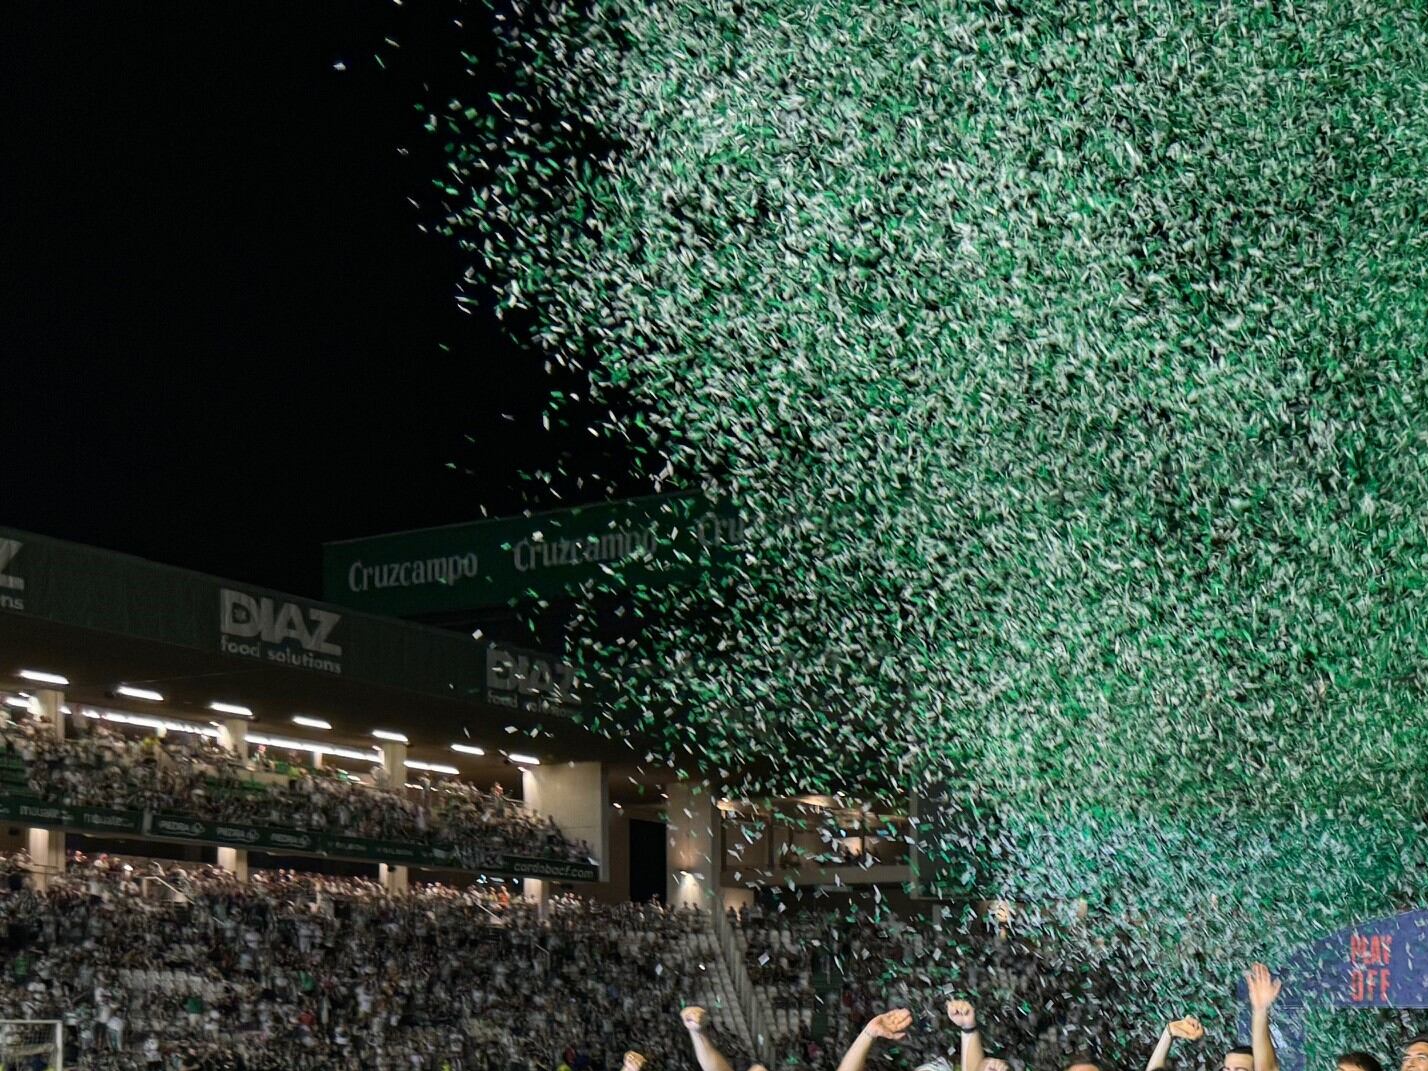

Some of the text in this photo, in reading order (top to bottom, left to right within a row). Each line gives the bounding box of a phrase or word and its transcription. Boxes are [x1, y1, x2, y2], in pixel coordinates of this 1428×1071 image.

[348, 551, 479, 594] Cruzcampo
[219, 587, 343, 656] DIAZ
[220, 634, 342, 675] food solutions
